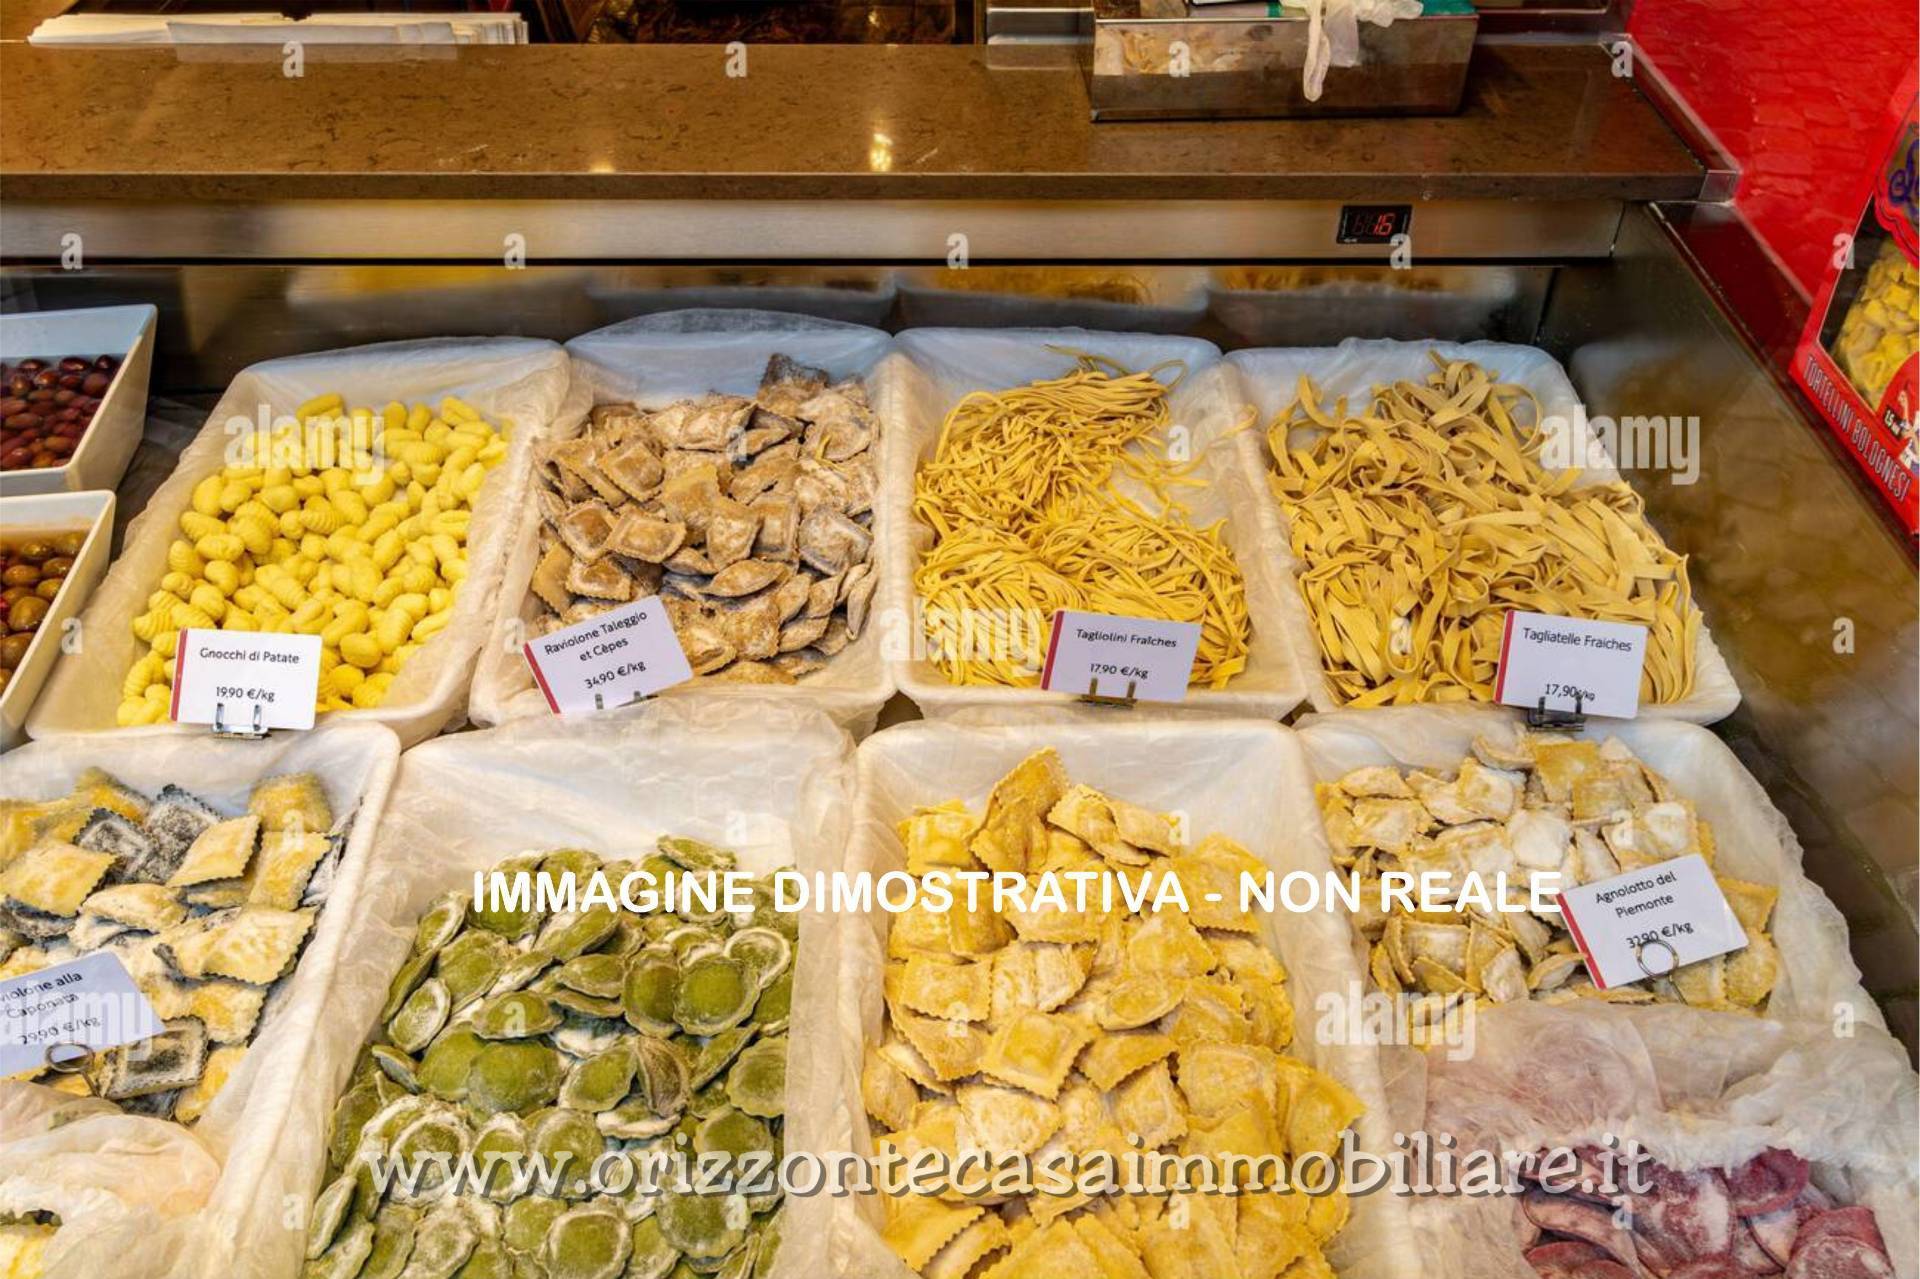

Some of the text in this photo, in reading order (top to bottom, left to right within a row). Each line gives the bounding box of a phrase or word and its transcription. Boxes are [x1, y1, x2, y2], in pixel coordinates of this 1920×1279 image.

[1804, 356, 1912, 502] TORTELLINI BOLOGNESI
[544, 611, 648, 656] Raviolone Taleggio
[1076, 628, 1128, 643] Tagliolini
[1523, 627, 1581, 646] Tagliatelle
[200, 647, 300, 664] Gnocchi di Patate
[579, 636, 629, 662] et Cèpes
[617, 661, 647, 677] €/kg
[1120, 666, 1148, 680] €/kg
[247, 687, 275, 702] €/kg
[1595, 871, 1677, 904] Agnolotto del
[1615, 895, 1674, 919] Piemonte
[1662, 922, 1694, 938] €/kg
[56, 973, 83, 986] alla
